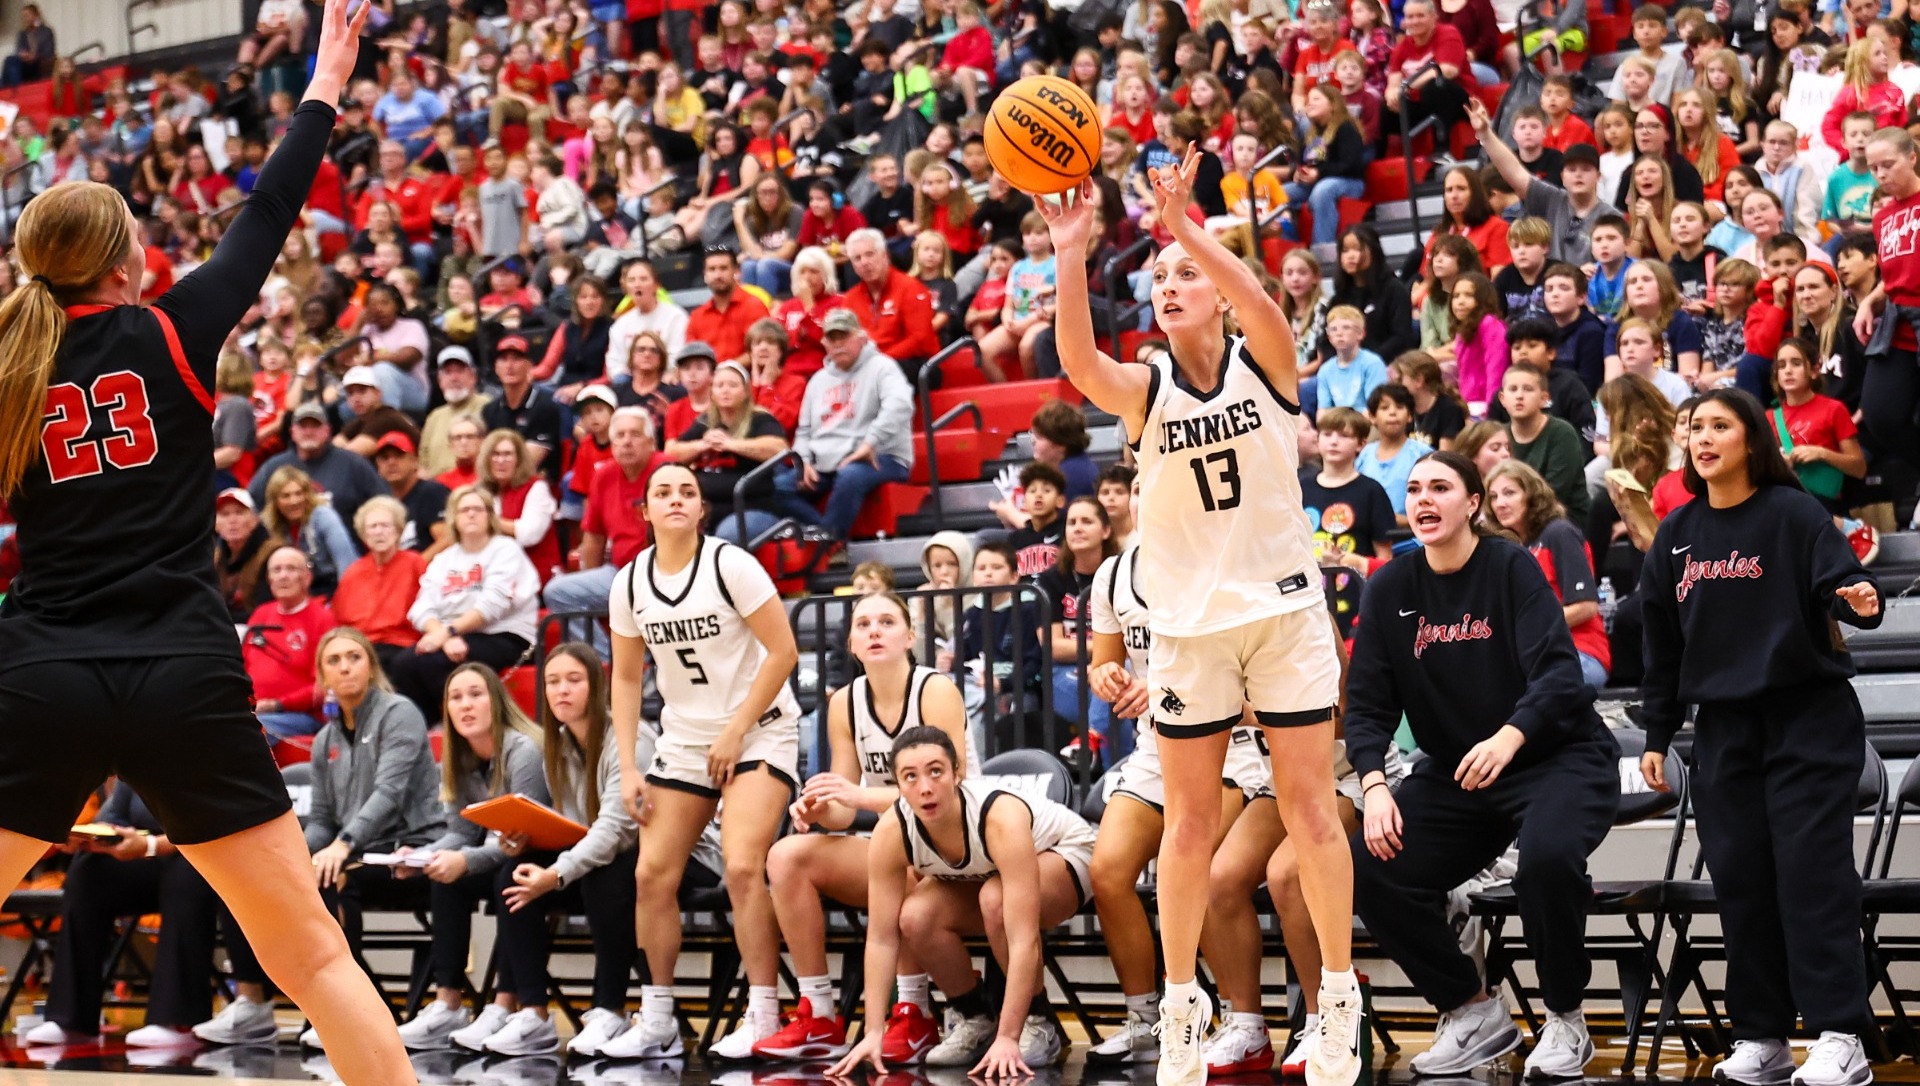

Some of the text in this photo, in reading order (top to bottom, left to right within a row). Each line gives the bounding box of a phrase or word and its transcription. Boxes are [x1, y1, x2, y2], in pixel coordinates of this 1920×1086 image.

[1007, 104, 1075, 168] Wilson
[1037, 86, 1089, 129] NCAA
[41, 369, 159, 484] 23
[1159, 398, 1262, 455] JENNIES
[1189, 448, 1241, 512] 13
[644, 614, 721, 645] JENNIES
[675, 648, 709, 685] 5
